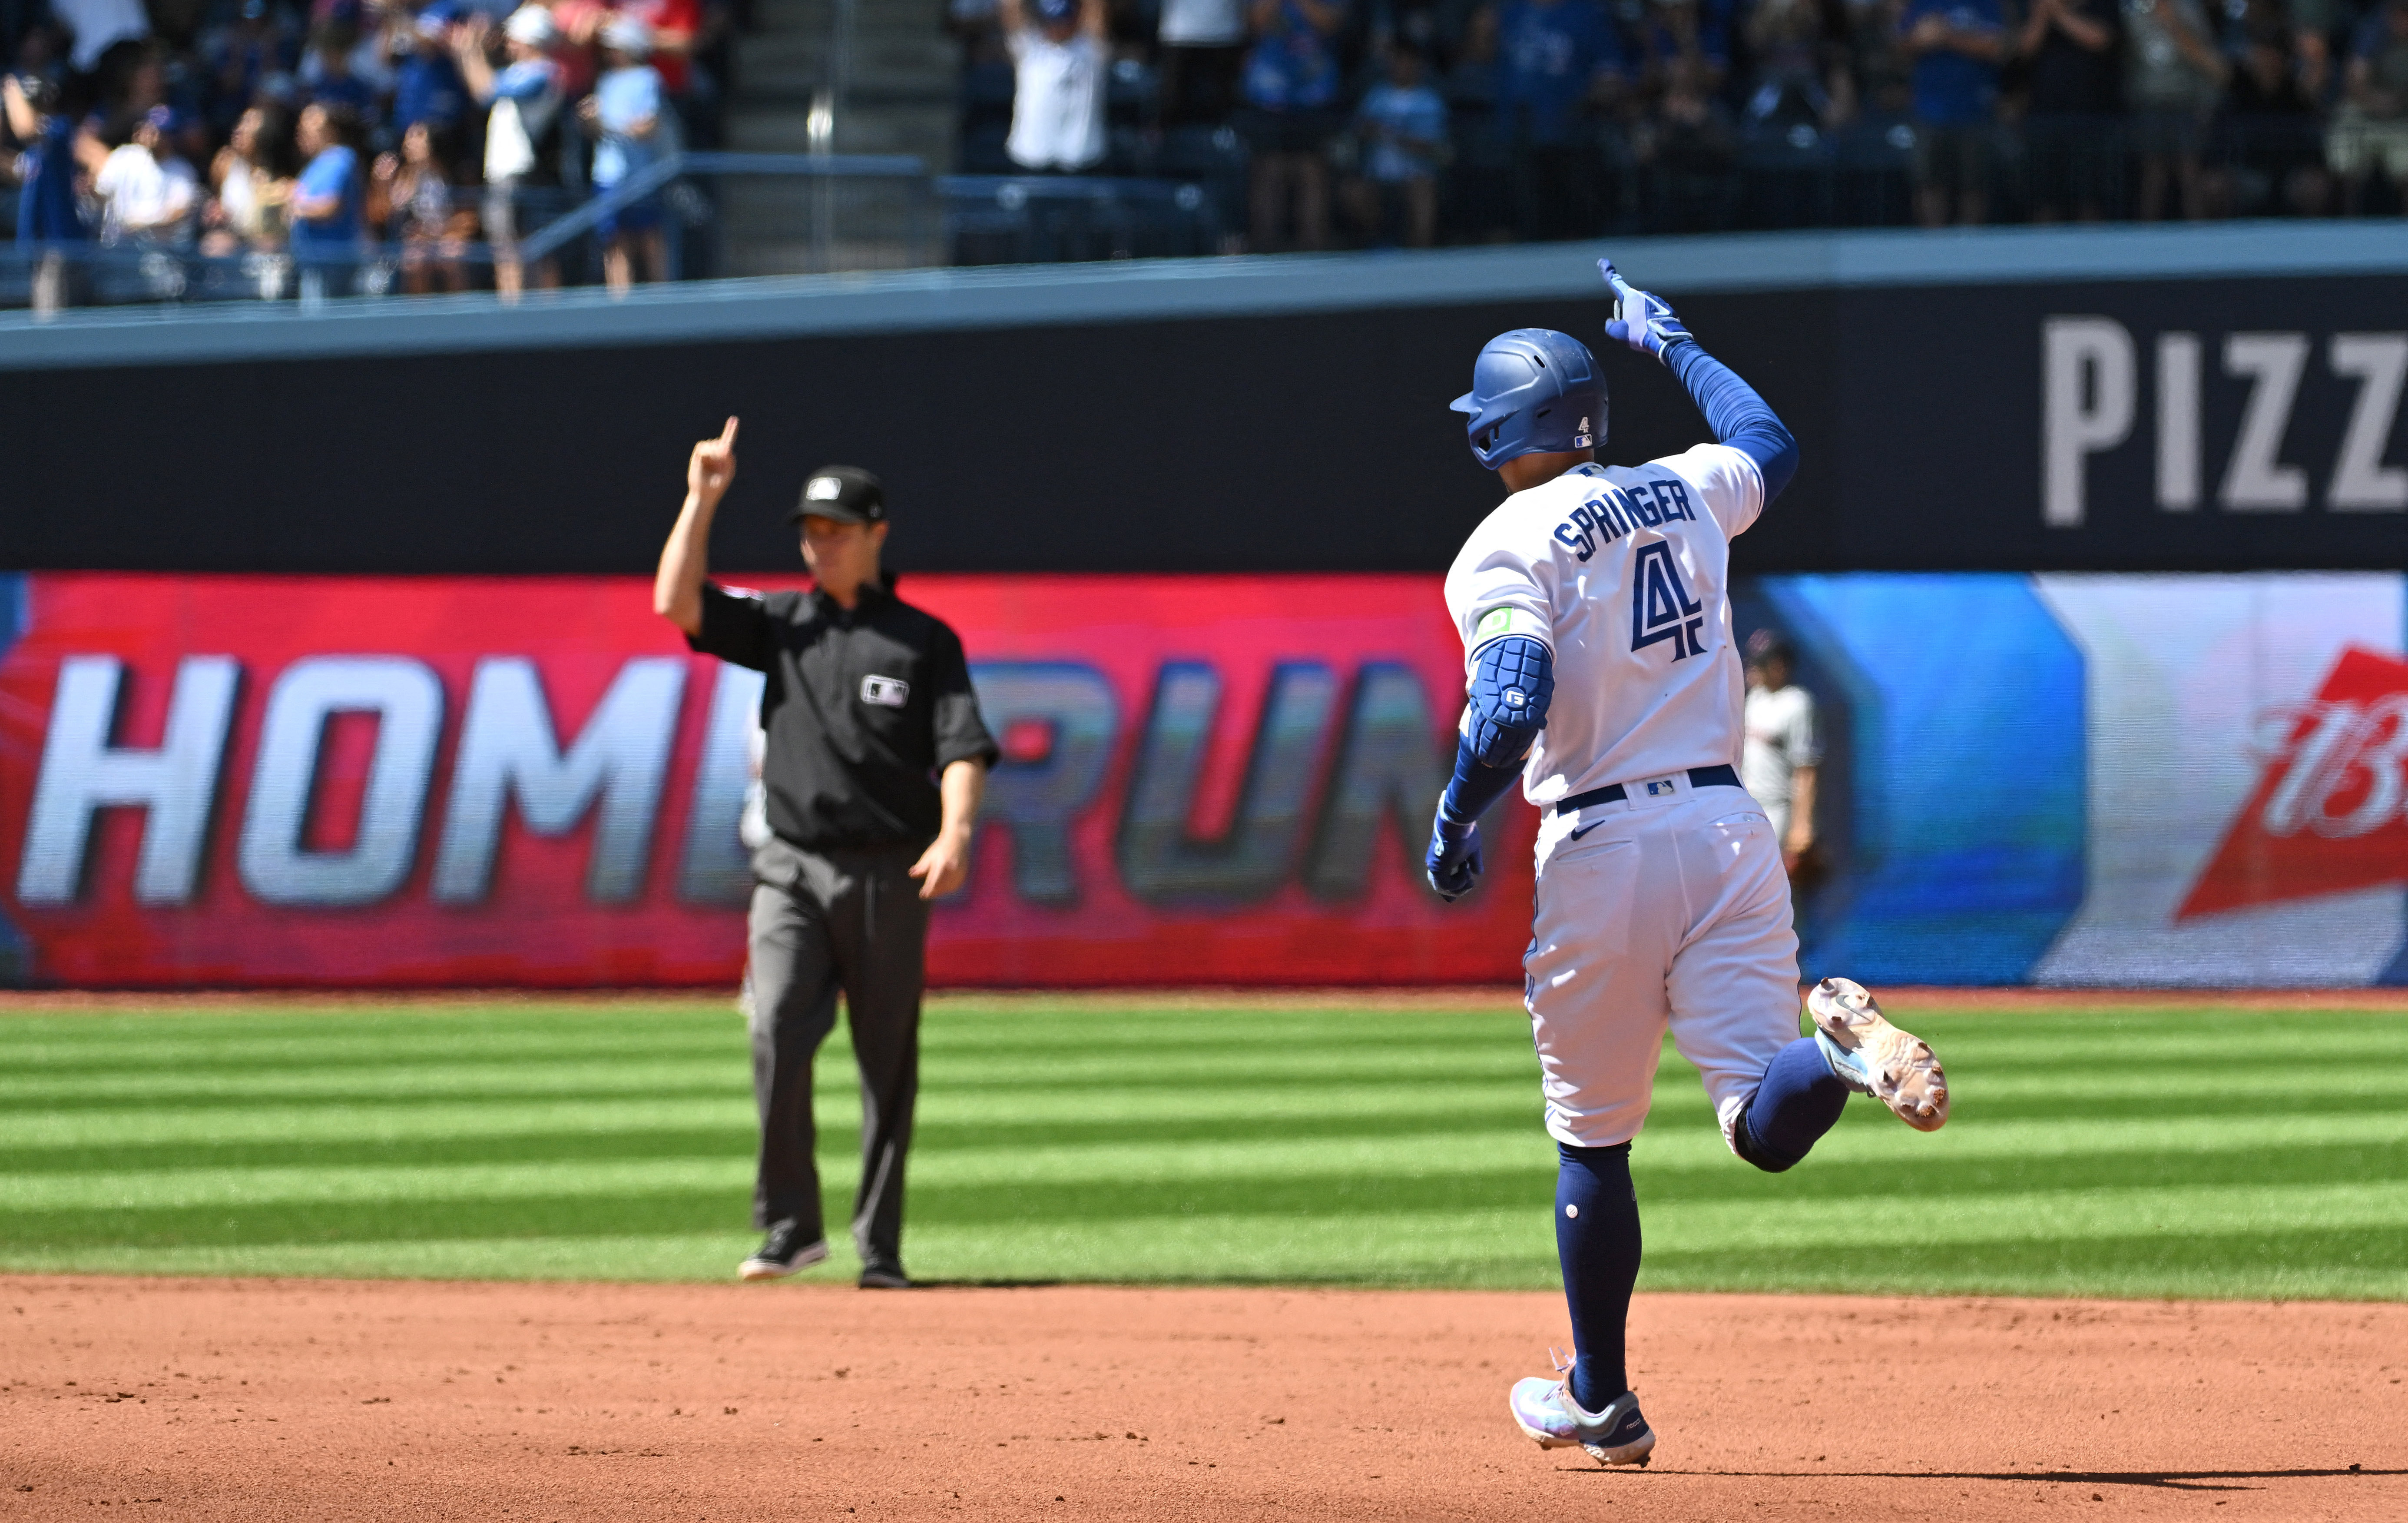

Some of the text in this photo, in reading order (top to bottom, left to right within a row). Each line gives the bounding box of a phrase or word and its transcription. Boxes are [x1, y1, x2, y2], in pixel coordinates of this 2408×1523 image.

[1578, 417, 1590, 434] 4
[1553, 479, 1696, 562] SPRINGER
[1631, 540, 1708, 663] 4
